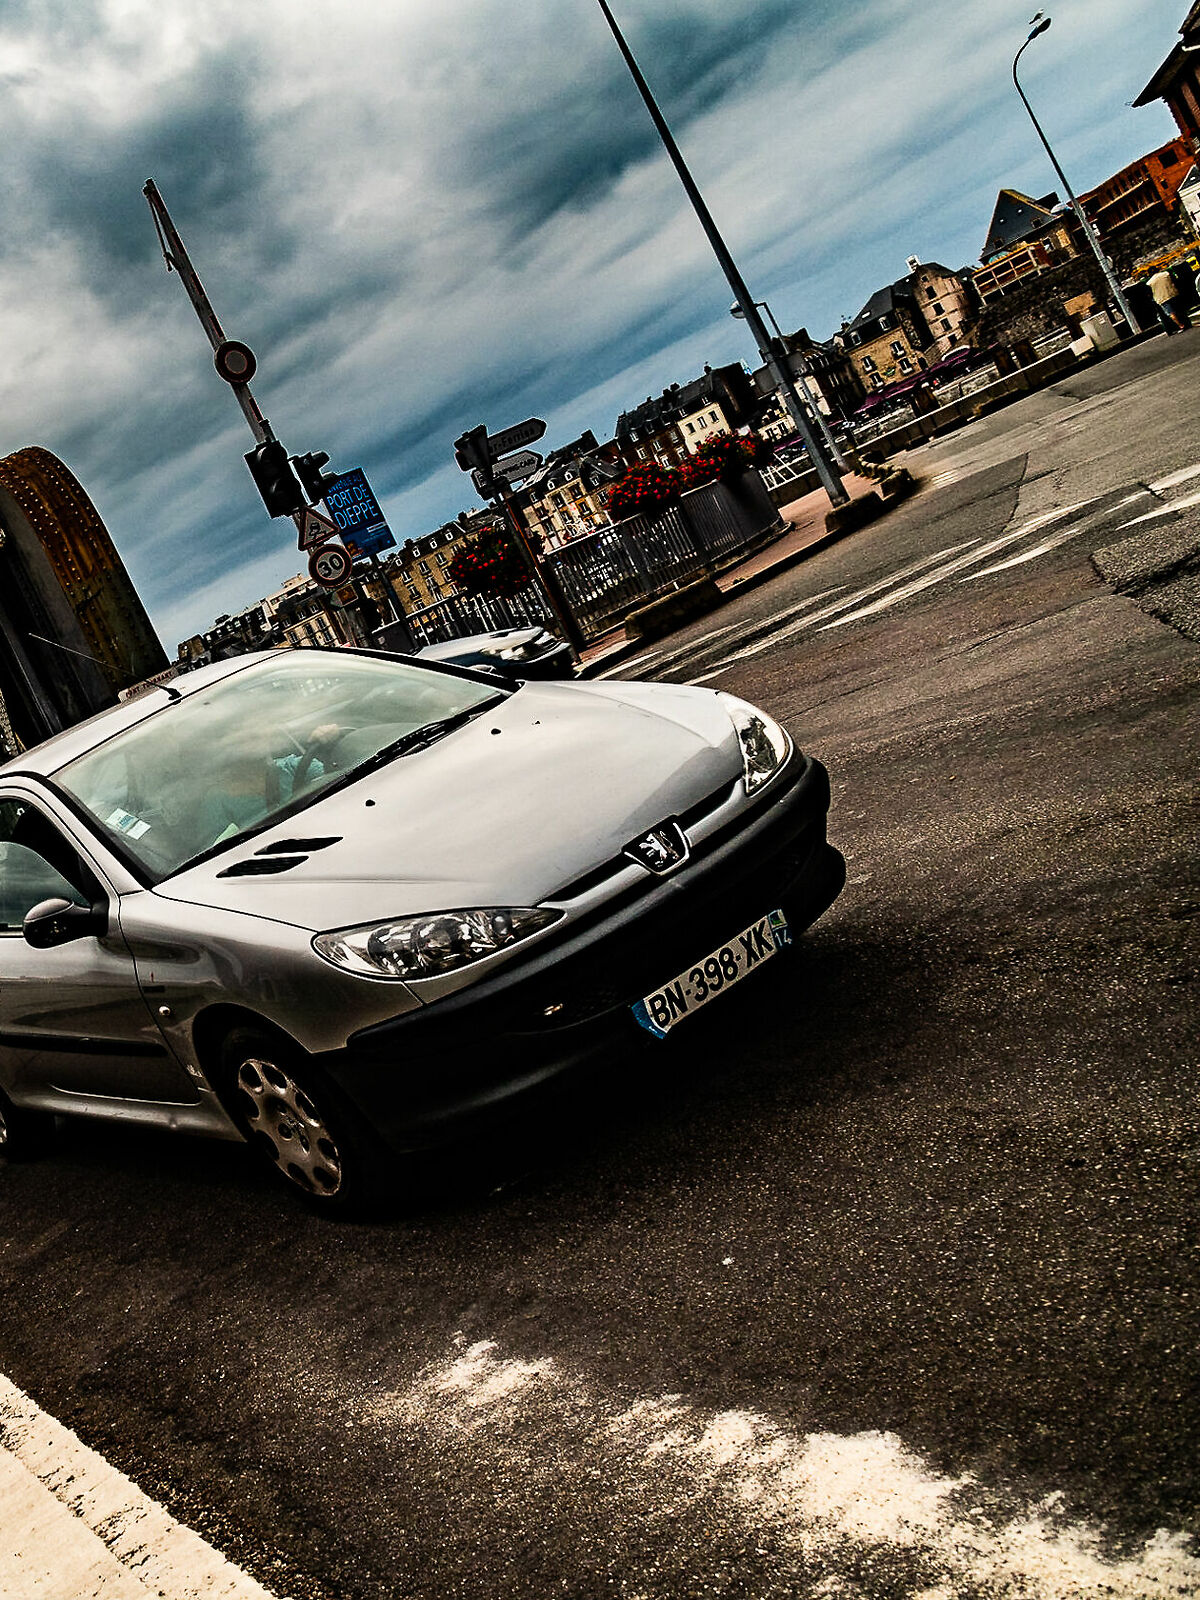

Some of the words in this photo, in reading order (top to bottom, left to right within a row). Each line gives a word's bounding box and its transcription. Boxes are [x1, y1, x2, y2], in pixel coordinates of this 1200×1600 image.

[489, 428, 536, 450] ar-Ferries
[327, 489, 354, 511] PORT
[353, 483, 370, 501] DE
[334, 499, 379, 530] DIEPPE
[318, 554, 344, 578] 30
[649, 919, 775, 1029] BN-398-XK
[774, 929, 792, 947] 14
